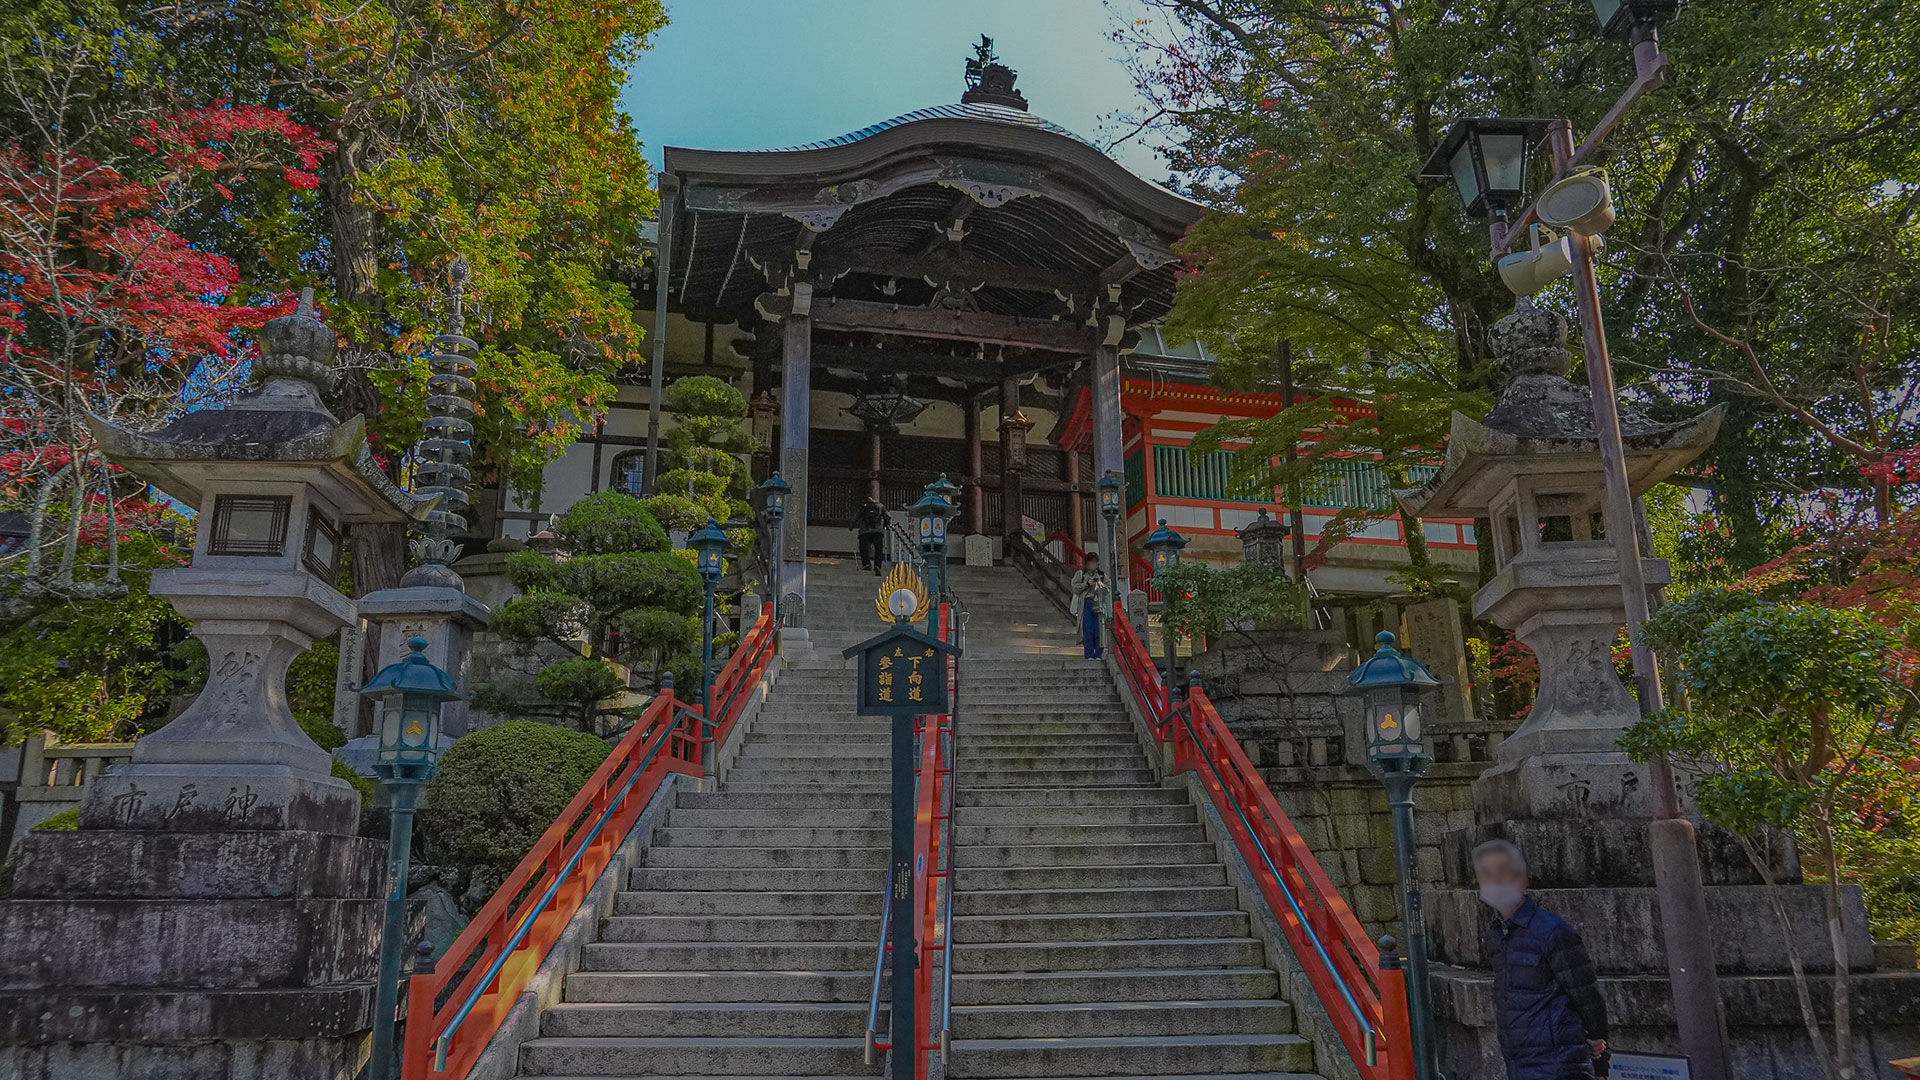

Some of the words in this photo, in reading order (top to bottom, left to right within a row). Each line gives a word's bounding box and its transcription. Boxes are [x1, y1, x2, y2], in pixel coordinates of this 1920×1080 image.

[894, 647, 904, 657] 左
[925, 648, 935, 657] 右
[908, 656, 923, 702] 下向道
